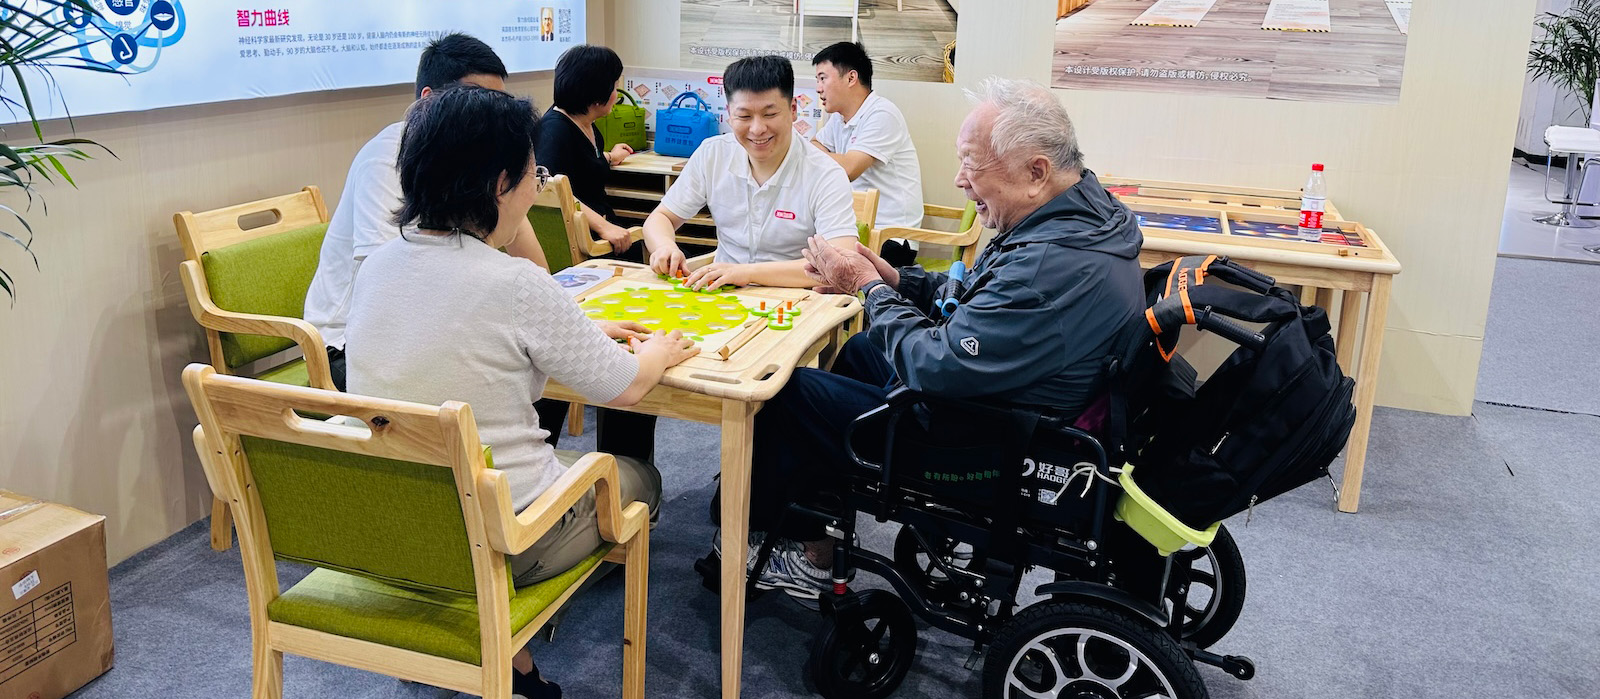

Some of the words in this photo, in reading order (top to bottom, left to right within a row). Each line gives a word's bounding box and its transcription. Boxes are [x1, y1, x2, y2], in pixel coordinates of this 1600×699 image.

[236, 9, 290, 27] 智力曲线
[1038, 462, 1070, 479] 好哥
